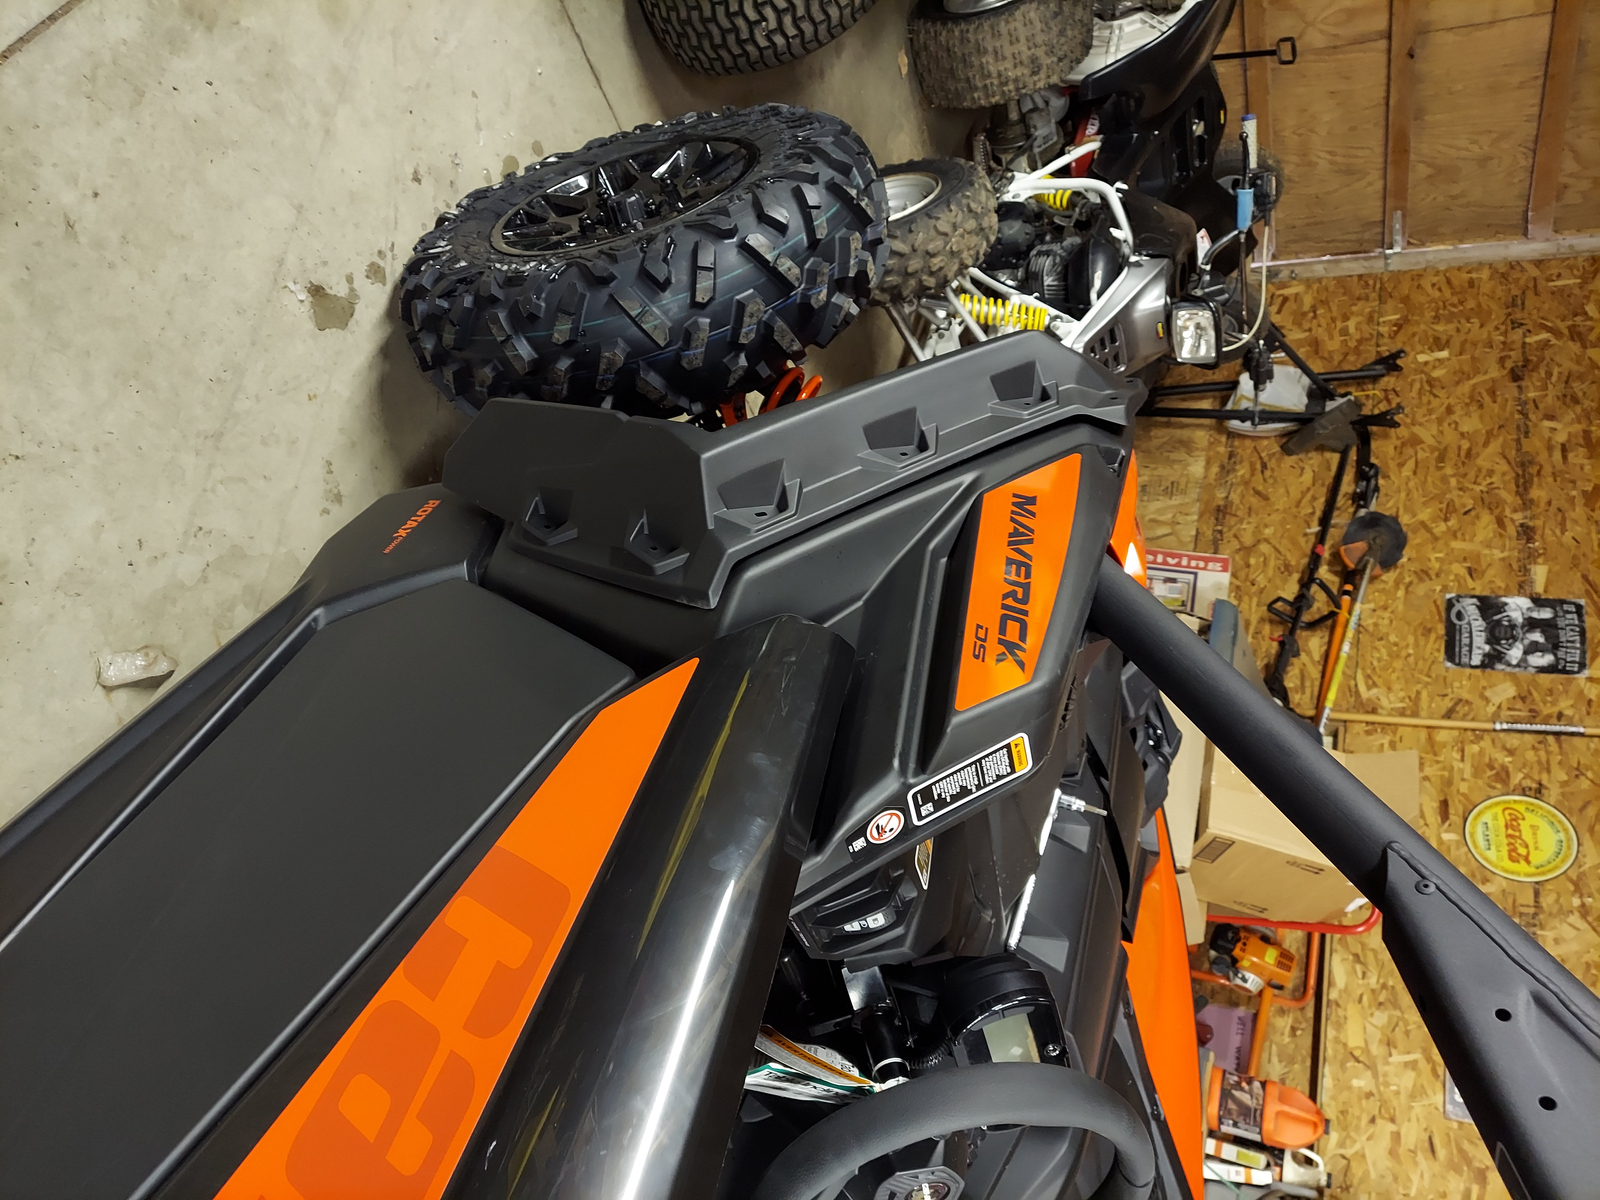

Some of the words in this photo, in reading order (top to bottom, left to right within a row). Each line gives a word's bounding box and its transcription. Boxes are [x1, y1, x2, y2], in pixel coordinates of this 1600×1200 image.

[392, 499, 441, 537] ROTAX
[995, 492, 1038, 674] MAVERICK
[1461, 624, 1470, 665] GARAGE
